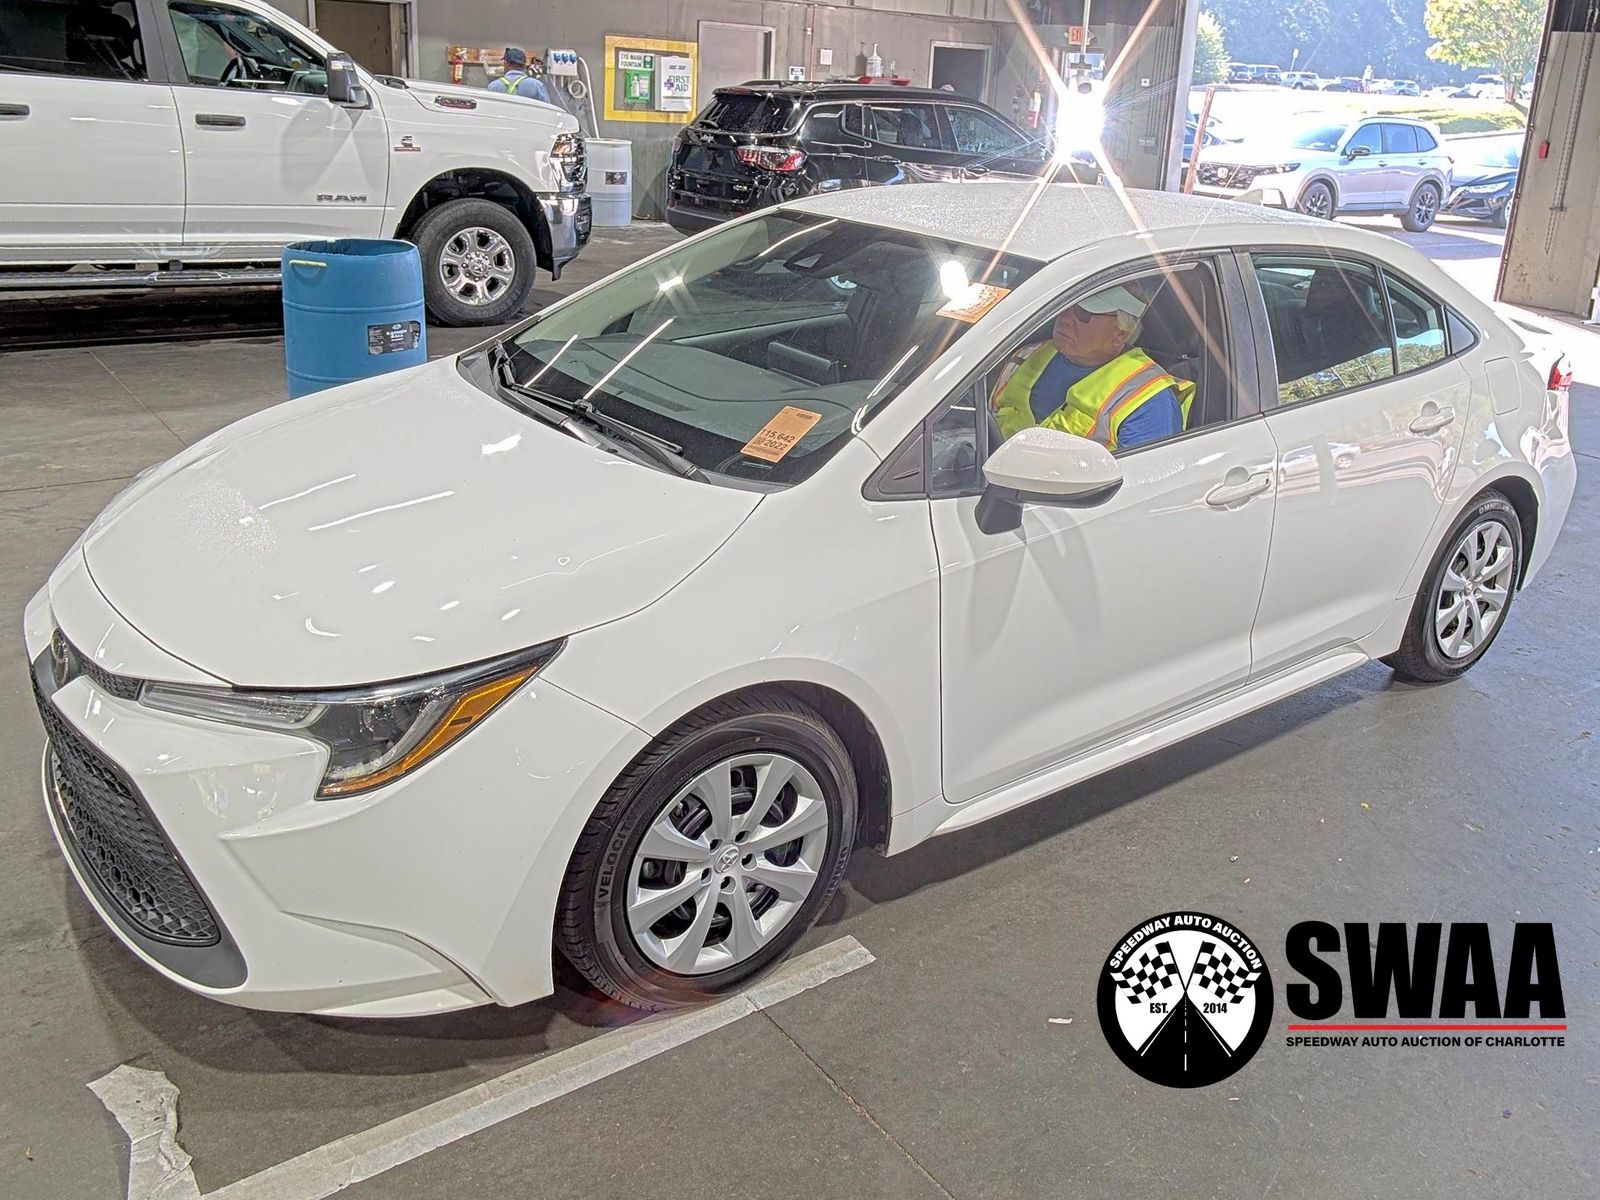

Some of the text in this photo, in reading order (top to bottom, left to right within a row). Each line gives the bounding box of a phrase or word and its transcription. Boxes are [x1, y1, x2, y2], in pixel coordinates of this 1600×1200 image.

[668, 75, 690, 83] FIRST
[674, 84, 689, 92] AID
[760, 429, 796, 444] 115,642
[763, 439, 788, 451] 2022
